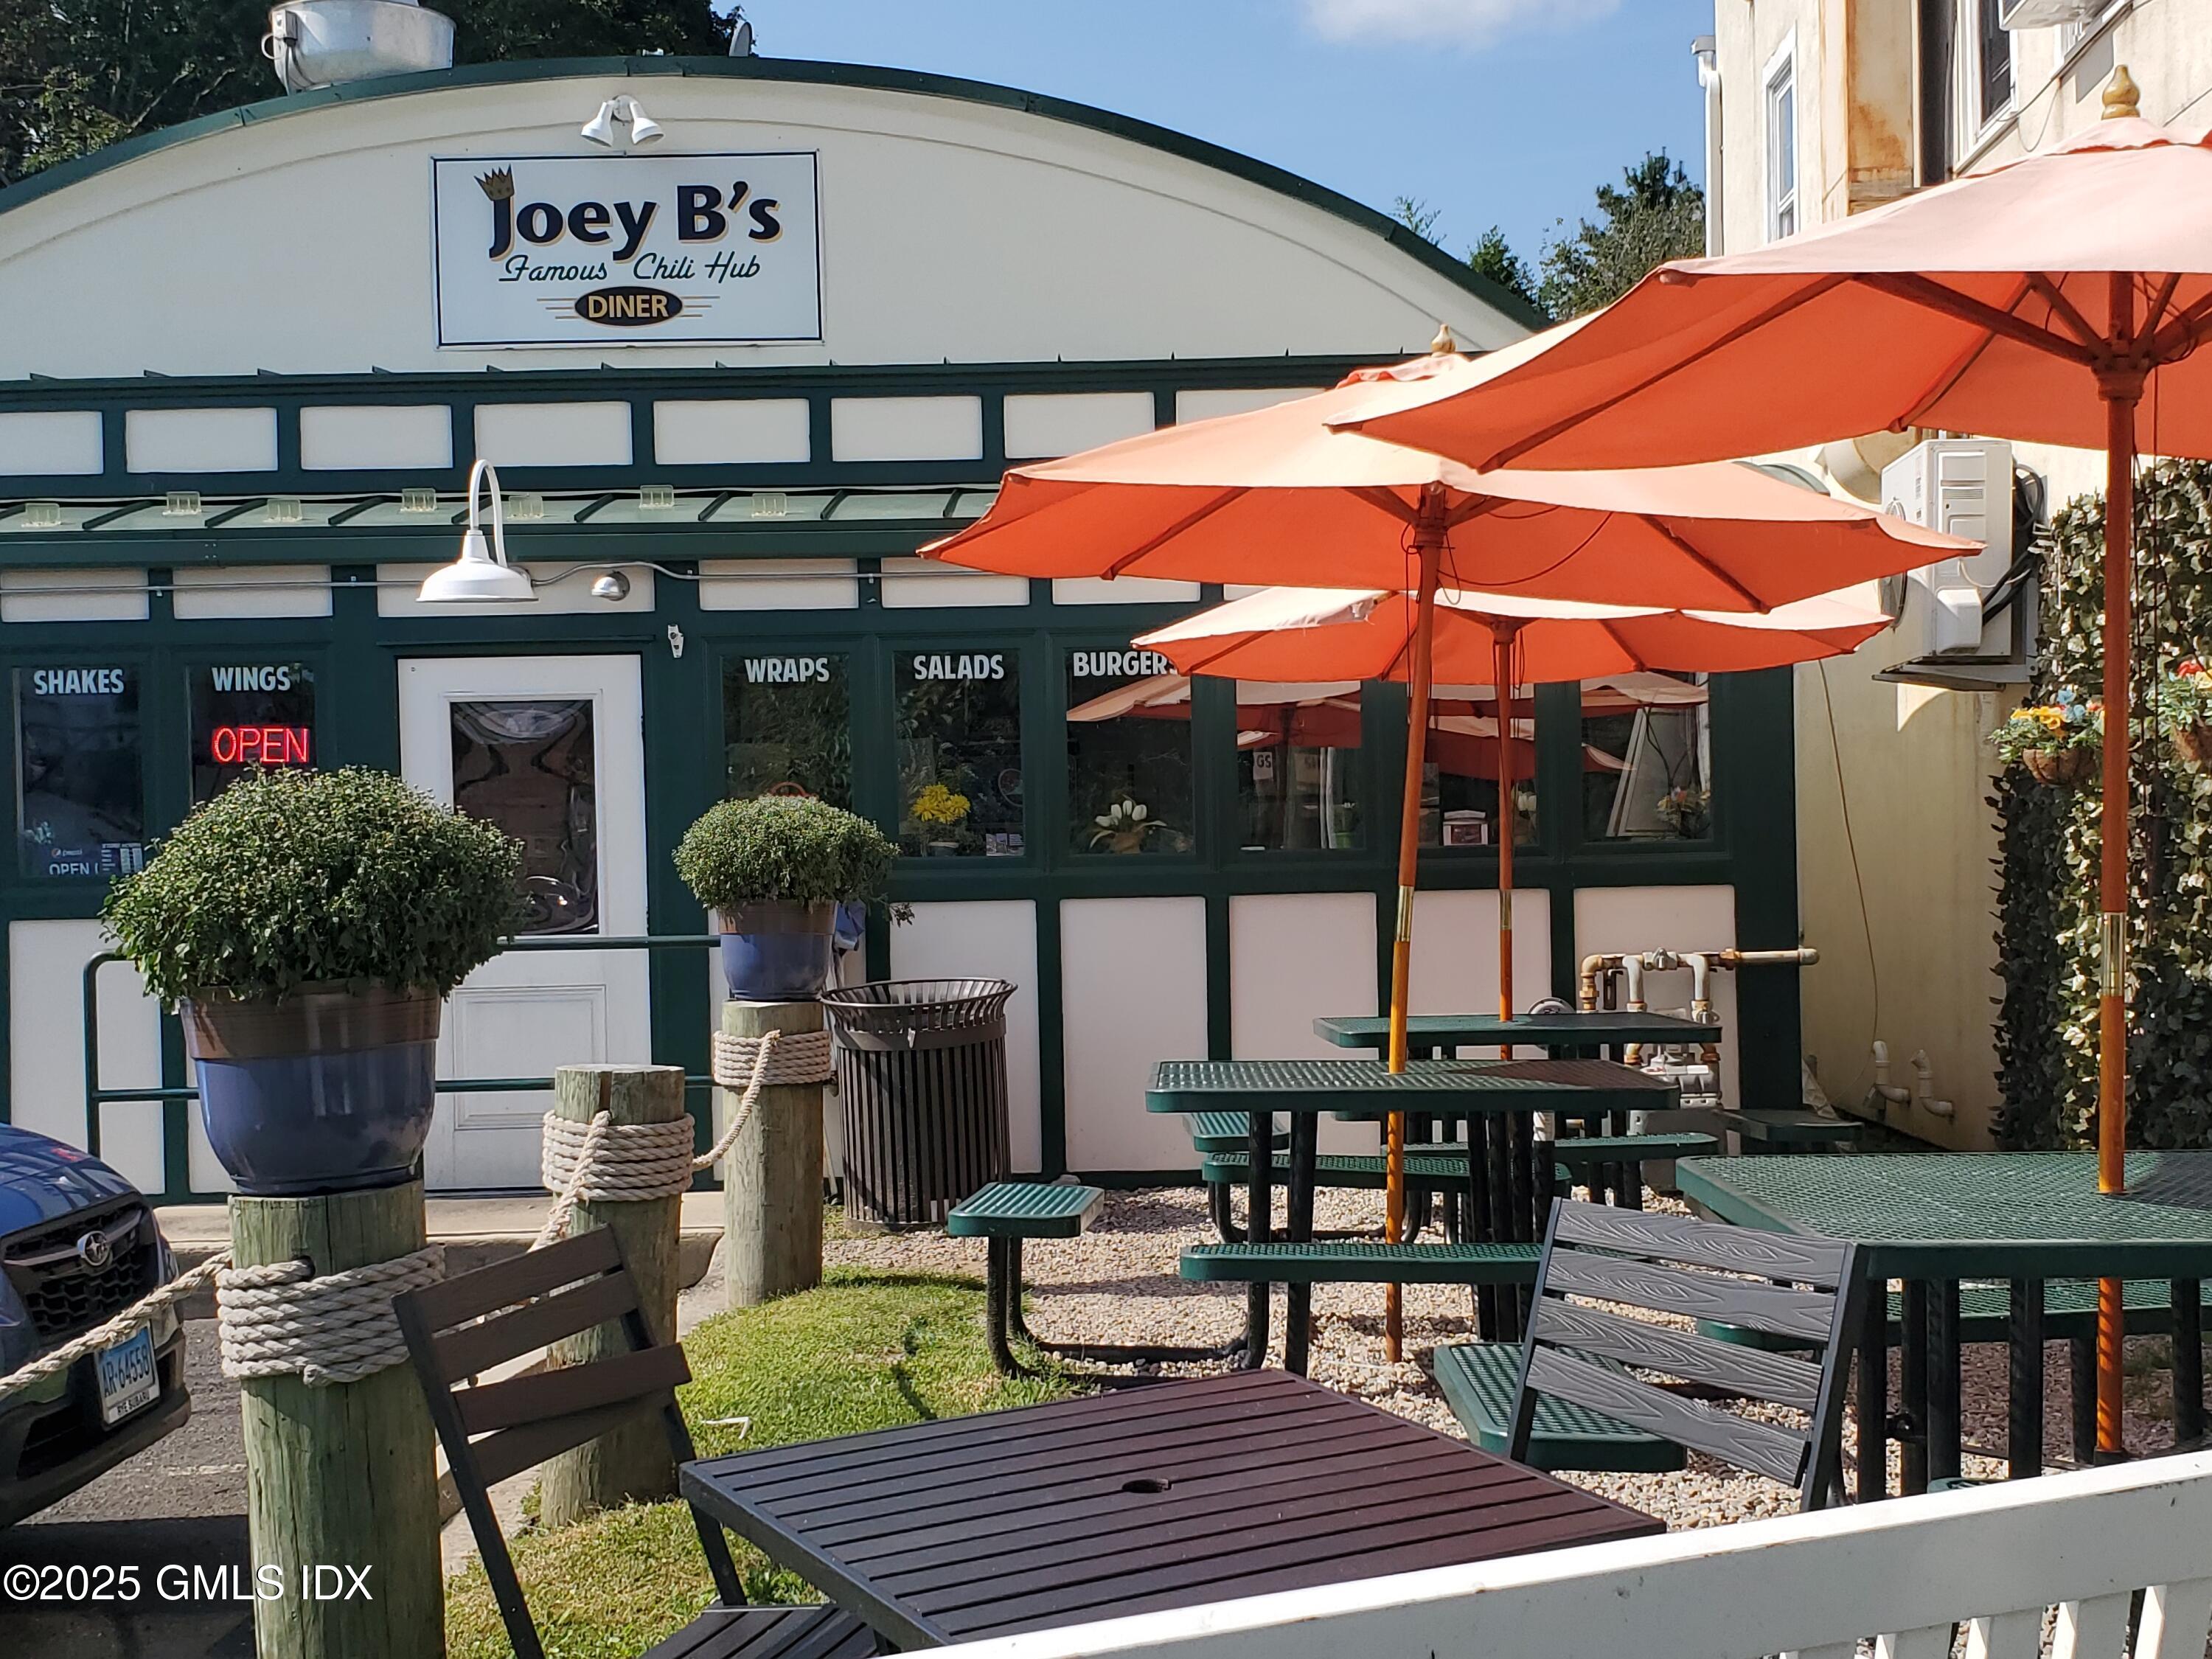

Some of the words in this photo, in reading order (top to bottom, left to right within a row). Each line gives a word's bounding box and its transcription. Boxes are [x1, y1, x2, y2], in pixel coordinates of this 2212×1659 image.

[490, 197, 658, 262] Joey
[677, 181, 782, 243] B's
[498, 254, 608, 282] Famous
[633, 253, 695, 279] Chili
[705, 251, 761, 284] Hub
[587, 294, 669, 319] DINER
[212, 666, 291, 691] WINGS
[745, 657, 830, 684] WRAPS
[914, 654, 1005, 680] SALADS
[34, 669, 125, 695] SHAKES
[212, 726, 310, 762] OPEN
